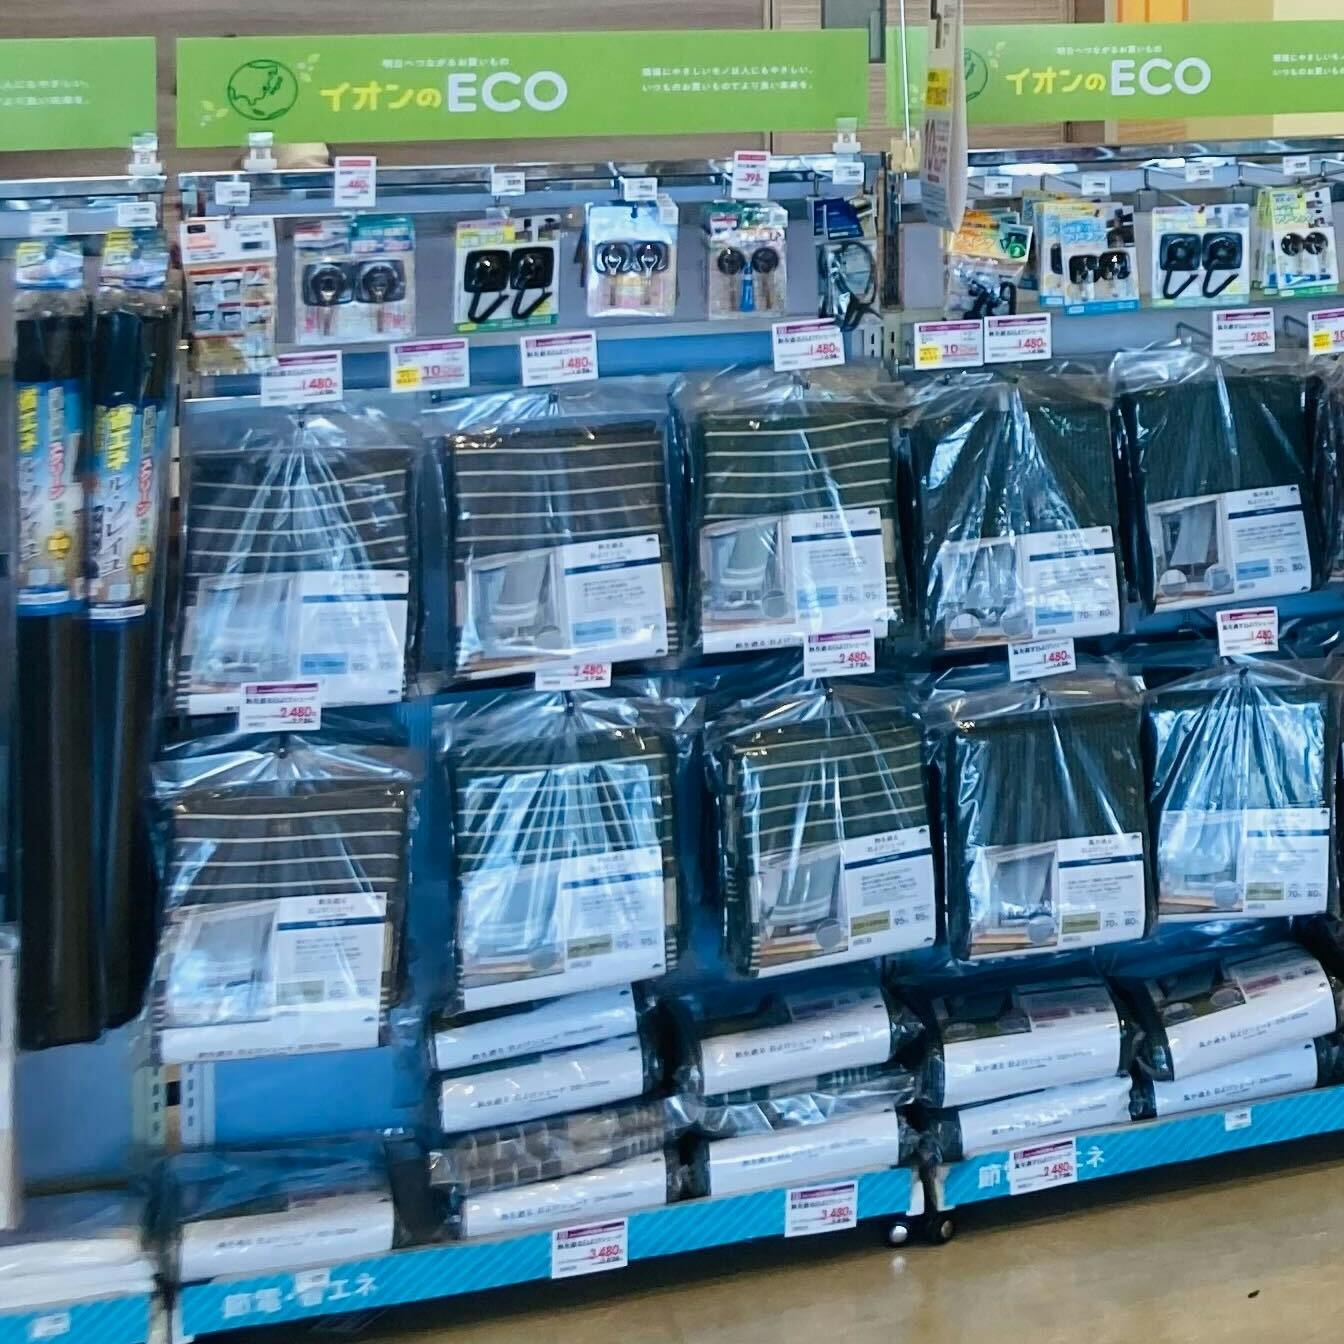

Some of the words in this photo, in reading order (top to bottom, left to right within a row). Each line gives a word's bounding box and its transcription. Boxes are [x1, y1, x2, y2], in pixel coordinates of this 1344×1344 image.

[320, 71, 568, 113] イオンのECO
[1007, 57, 1211, 96] イオンのECO
